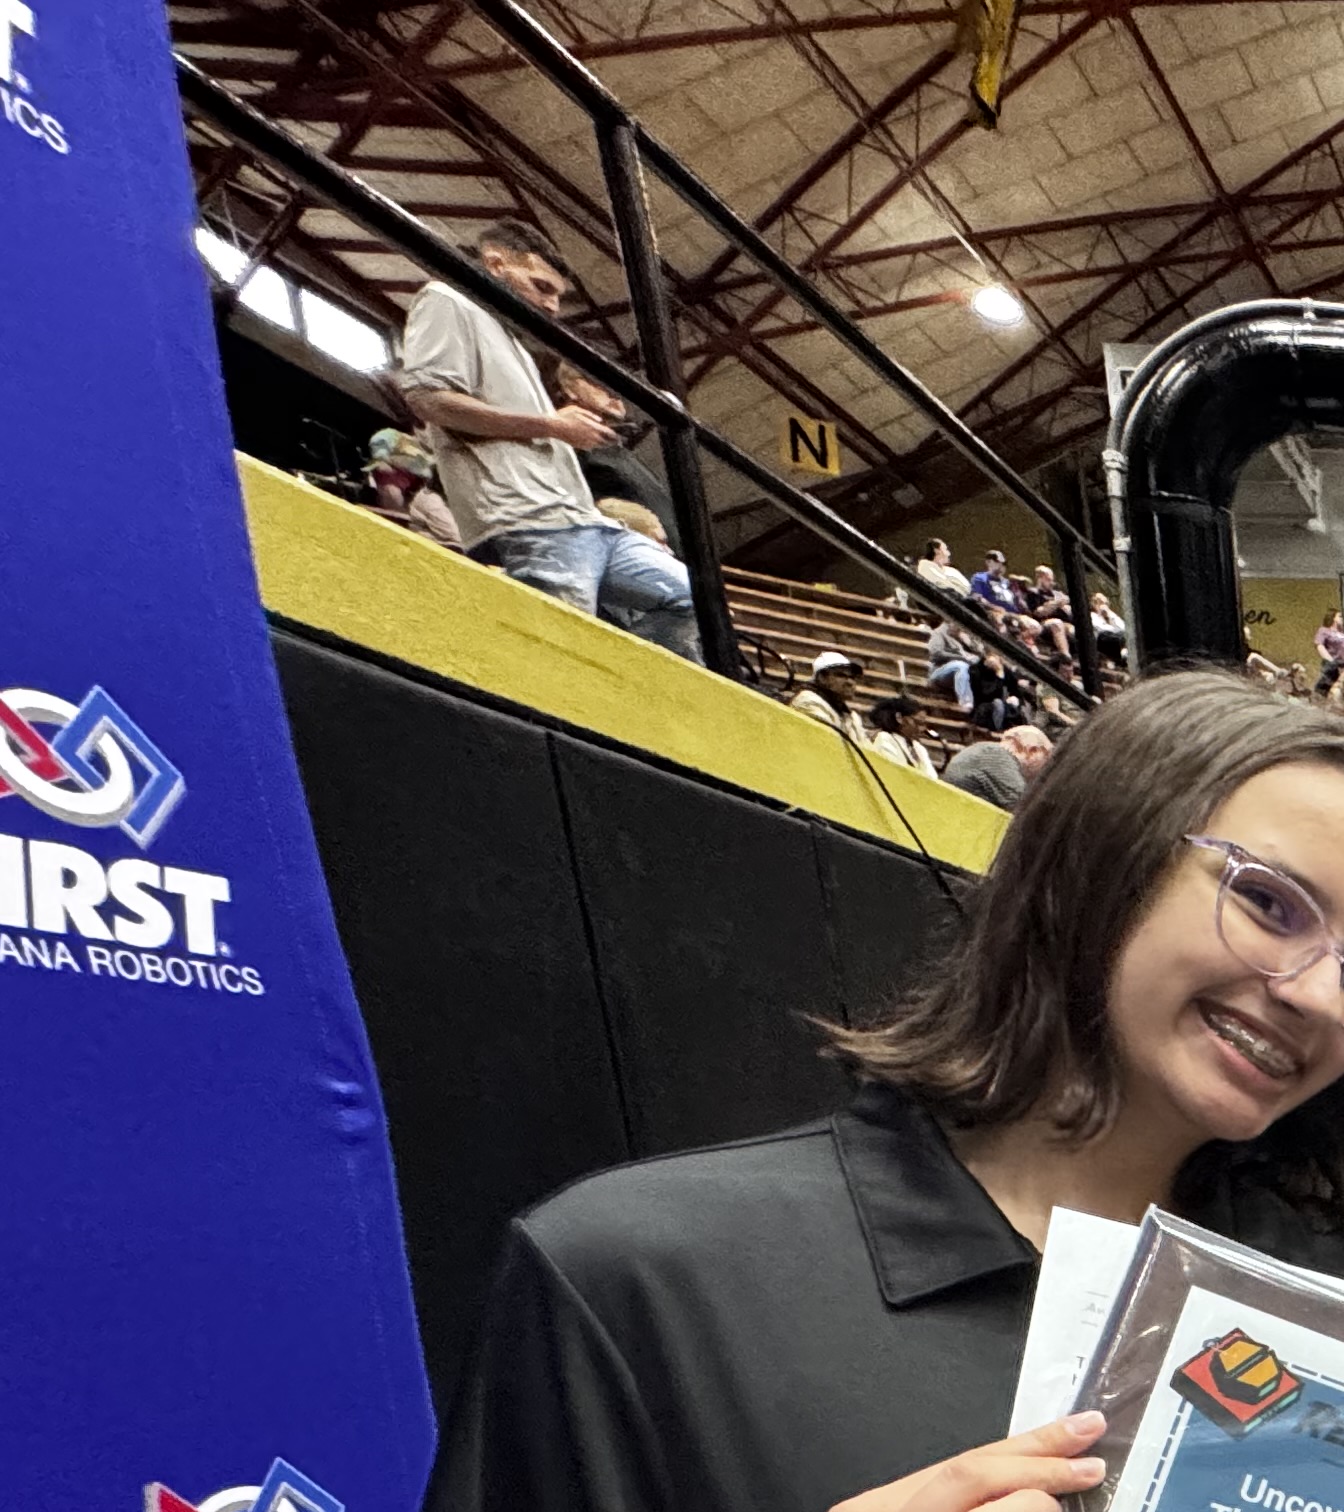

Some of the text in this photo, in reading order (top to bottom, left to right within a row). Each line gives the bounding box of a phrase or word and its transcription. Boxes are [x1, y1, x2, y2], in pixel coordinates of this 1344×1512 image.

[788, 417, 828, 469] N
[0, 833, 231, 956] IRST
[86, 945, 265, 996] ROBOTICS
